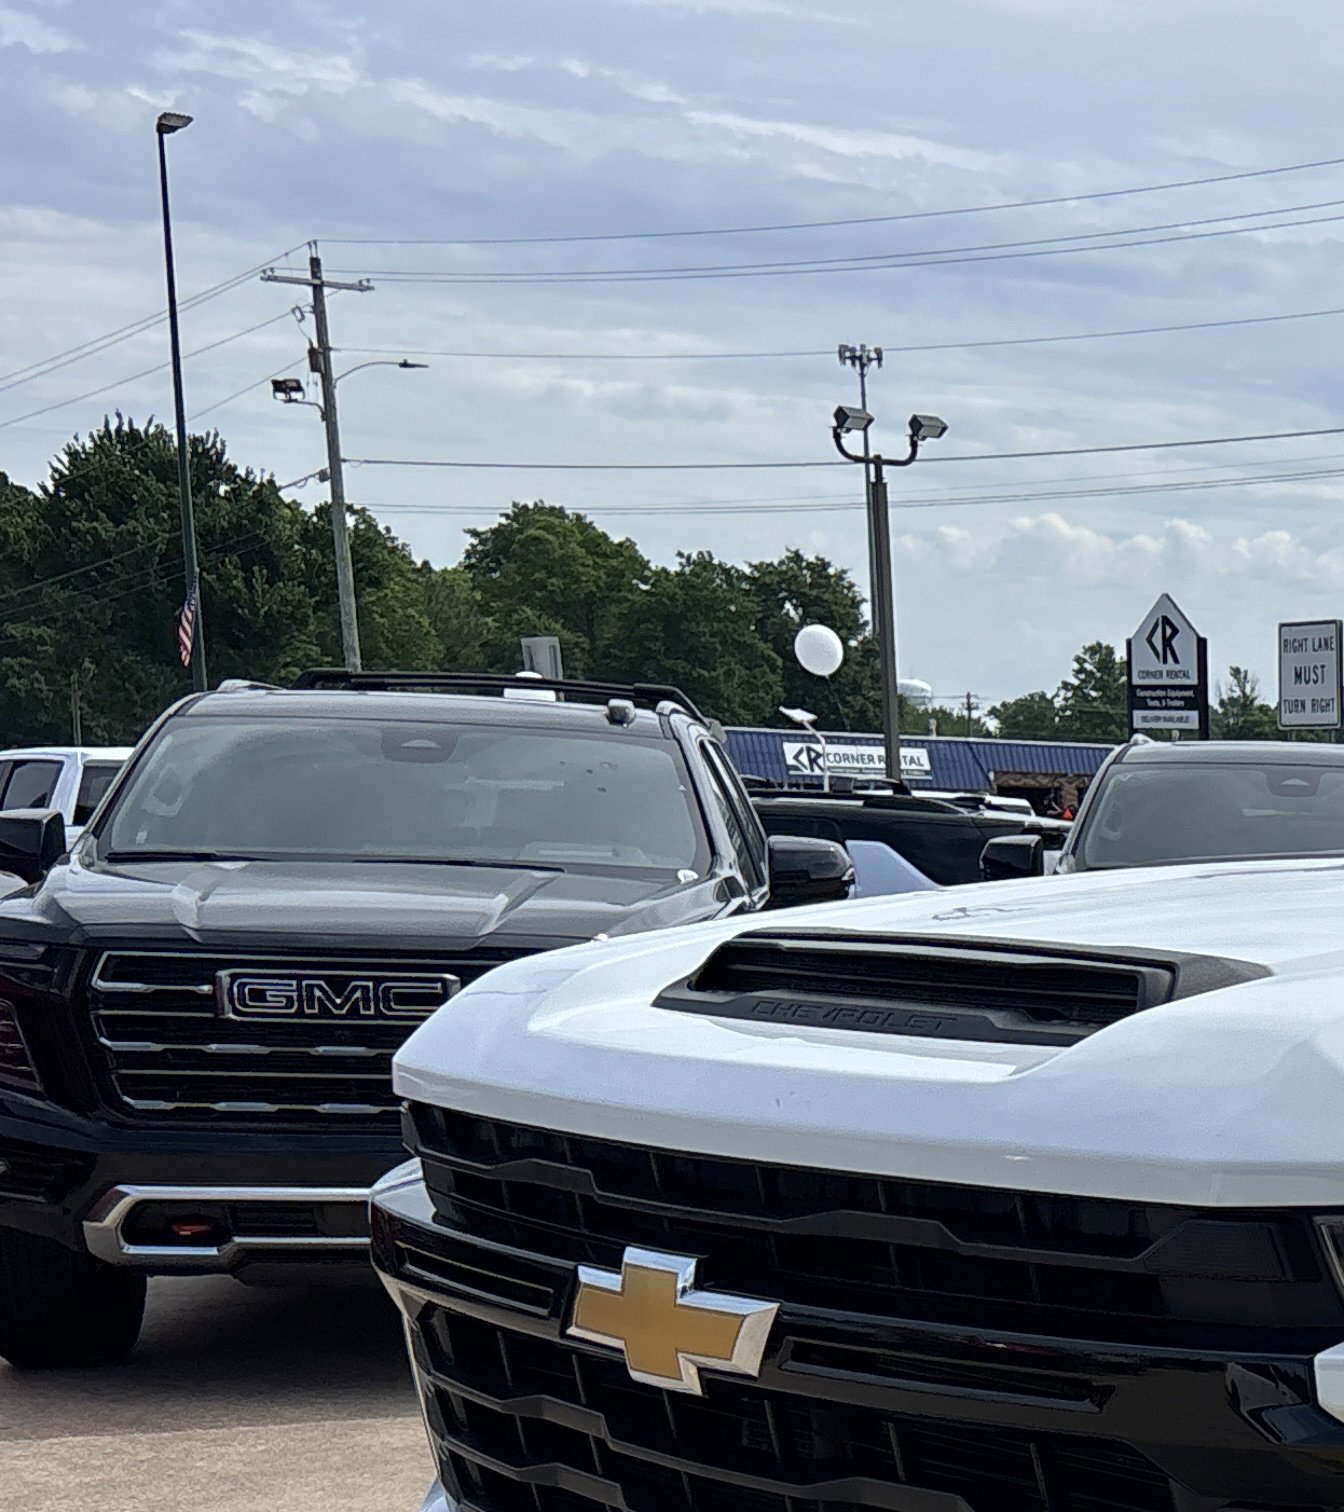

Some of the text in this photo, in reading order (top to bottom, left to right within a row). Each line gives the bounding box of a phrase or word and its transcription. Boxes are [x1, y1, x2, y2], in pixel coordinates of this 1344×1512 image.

[1283, 635, 1335, 654] RIGHT LANE
[1138, 669, 1191, 680] CORNER RENTAL
[1293, 664, 1326, 685] MUST
[1283, 697, 1335, 714] TURN RIGHT
[826, 752, 876, 766] CORNER
[877, 754, 925, 767] RTAL
[233, 978, 443, 1016] GMC
[751, 999, 959, 1032] CHEVROLET
